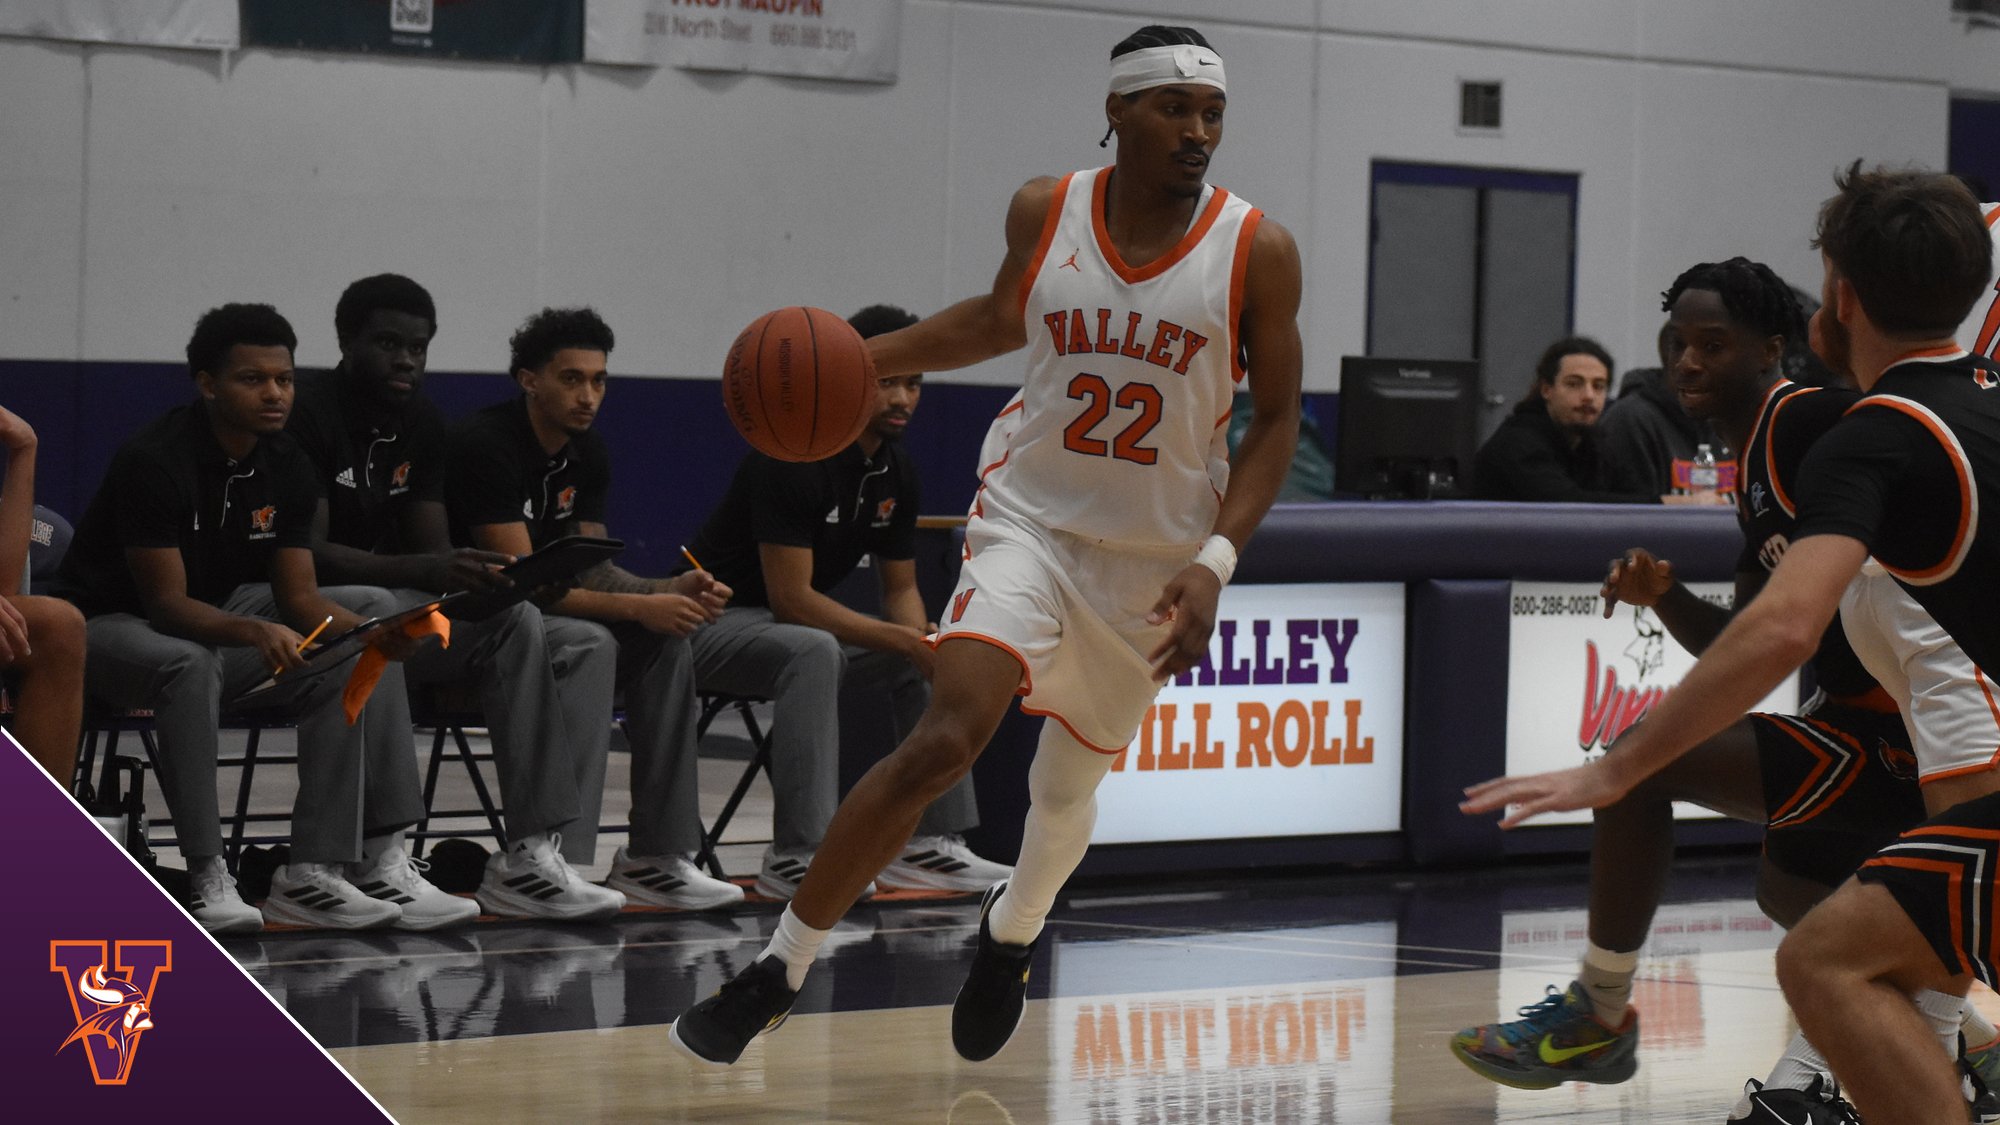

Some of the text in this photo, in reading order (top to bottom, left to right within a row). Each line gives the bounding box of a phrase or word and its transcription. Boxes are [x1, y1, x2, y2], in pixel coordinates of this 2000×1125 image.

[779, 337, 792, 378] MISSOURI
[1044, 308, 1208, 376] VALLEY
[1063, 372, 1164, 465] 22
[950, 587, 976, 625] V
[1512, 595, 1598, 616] 800-286-0087
[1164, 618, 1359, 687] ALLEY
[1110, 699, 1375, 773] ILL ROLL
